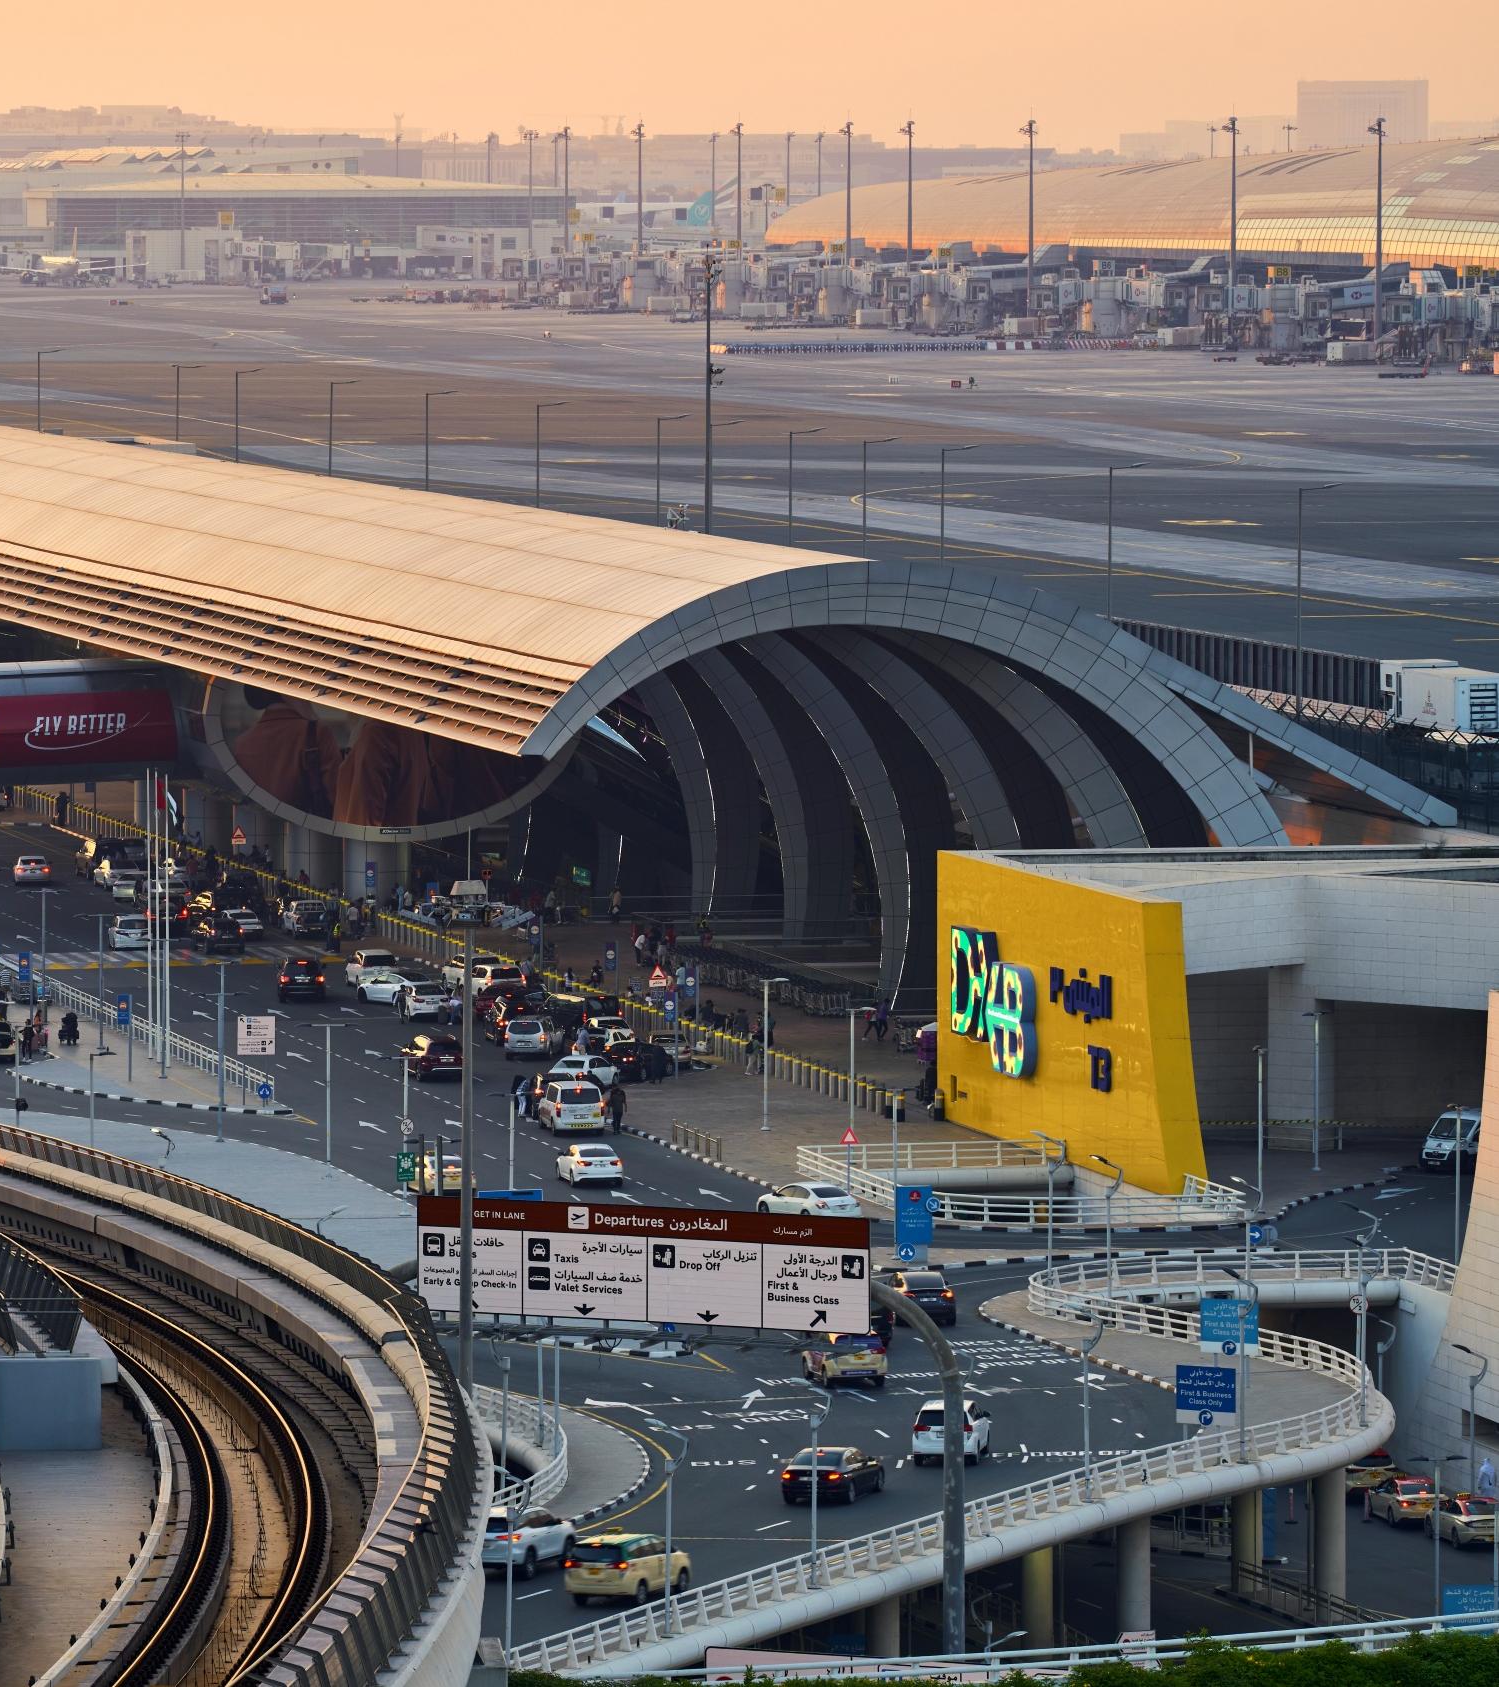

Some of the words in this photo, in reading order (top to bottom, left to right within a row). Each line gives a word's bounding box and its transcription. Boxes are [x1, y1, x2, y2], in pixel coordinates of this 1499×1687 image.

[1467, 266, 1481, 275] B9
[34, 716, 61, 736] FLY
[66, 713, 126, 735] BETTER
[1087, 1044, 1112, 1093] T3
[473, 1210, 490, 1219] GET
[492, 1211, 501, 1219] IN
[503, 1211, 526, 1220] LANE
[594, 1213, 664, 1229] Departures
[669, 1217, 728, 1232] المغادرون
[473, 1237, 505, 1248] حافلات
[582, 1242, 607, 1253] الأجرة
[449, 1249, 478, 1259] Bus
[609, 1244, 643, 1256] سيارات
[702, 1249, 731, 1261] الركاب
[554, 1254, 580, 1264] Taxis
[733, 1250, 757, 1263] تنزيل
[783, 1253, 807, 1266] الأولى
[809, 1256, 838, 1267] الدرجة
[679, 1260, 702, 1271] Drop
[705, 1261, 721, 1271] Off
[554, 1270, 594, 1282] السيارات
[596, 1272, 617, 1283] صف
[776, 1267, 808, 1280] الأعمال
[423, 1277, 444, 1287] Early
[445, 1278, 452, 1286] &
[481, 1279, 518, 1289] Check-In
[619, 1274, 643, 1284] خدمة
[554, 1283, 580, 1293] Valet
[582, 1284, 623, 1295] Services
[767, 1281, 790, 1291] First
[792, 1281, 799, 1291] &
[767, 1293, 810, 1304] Business
[813, 1295, 840, 1306] Class
[1212, 1328, 1231, 1336] Class
[975, 1352, 1060, 1360] CLASS
[885, 1371, 940, 1379] DROP
[1180, 1389, 1195, 1397] First
[1202, 1390, 1232, 1399] Business
[1188, 1397, 1207, 1405] Class
[1207, 1398, 1223, 1407] Only
[725, 1408, 807, 1418] TAXI
[740, 1414, 810, 1423] ONLY
[1030, 1450, 1092, 1458] DROP
[690, 1459, 757, 1467] BUS
